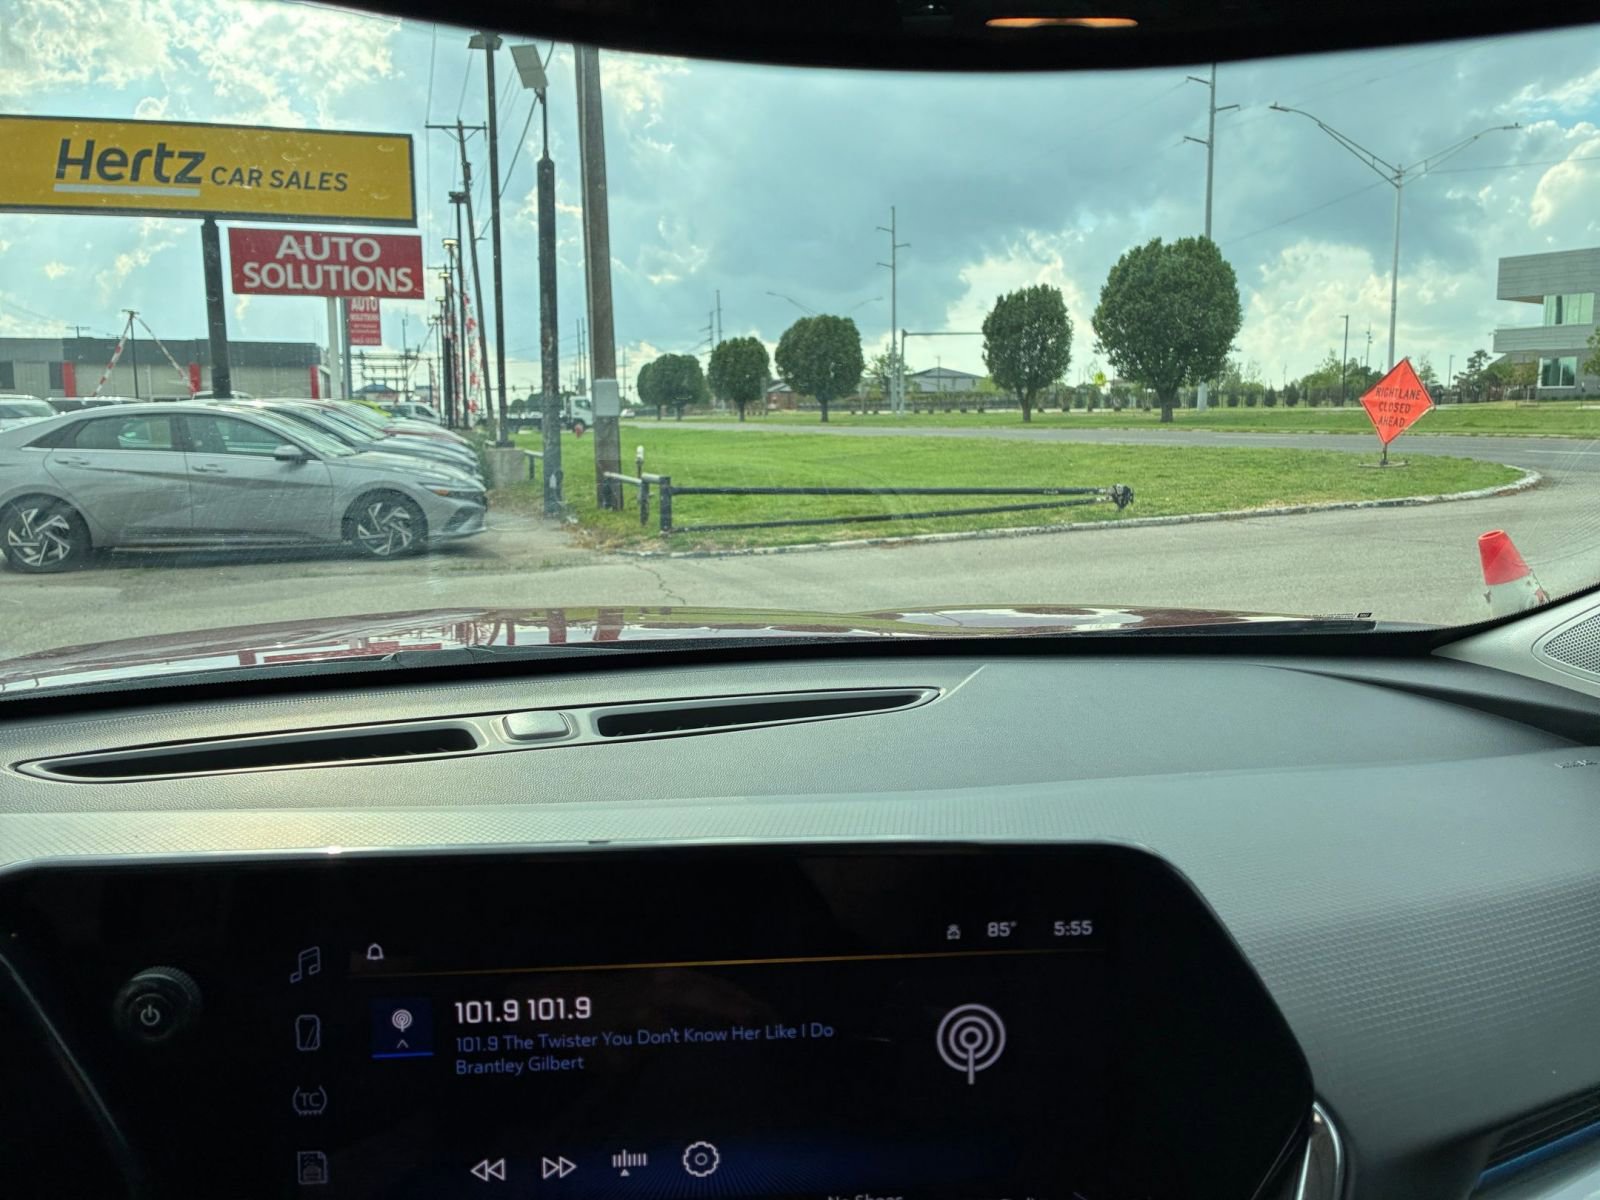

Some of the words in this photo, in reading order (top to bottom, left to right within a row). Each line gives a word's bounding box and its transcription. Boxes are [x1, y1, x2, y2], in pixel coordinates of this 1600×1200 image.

[55, 138, 206, 184] Hertz
[211, 166, 263, 188] CAR
[269, 169, 348, 192] SALES
[275, 234, 381, 263] AUTO
[242, 261, 414, 292] SOLUTIONS
[1375, 386, 1400, 398] RIGHT
[1399, 388, 1421, 400] LANE
[1378, 401, 1411, 414] CLOSED
[1377, 416, 1406, 428] AHEAD
[987, 920, 1018, 938] 85°
[1053, 920, 1093, 936] 5:55
[454, 999, 519, 1024] 101.9
[527, 996, 592, 1021] 101.9
[456, 1036, 499, 1052] 101.9
[502, 1035, 534, 1050] The
[537, 1032, 598, 1049] Twister
[602, 1031, 632, 1046] You
[637, 1028, 680, 1045] Don't
[684, 1028, 728, 1043] Know
[732, 1026, 761, 1041] Her
[765, 1024, 797, 1040] Like
[801, 1023, 806, 1038] I
[810, 1022, 835, 1038] Do
[455, 1058, 525, 1077] Brantley
[527, 1055, 585, 1073] Gilbert
